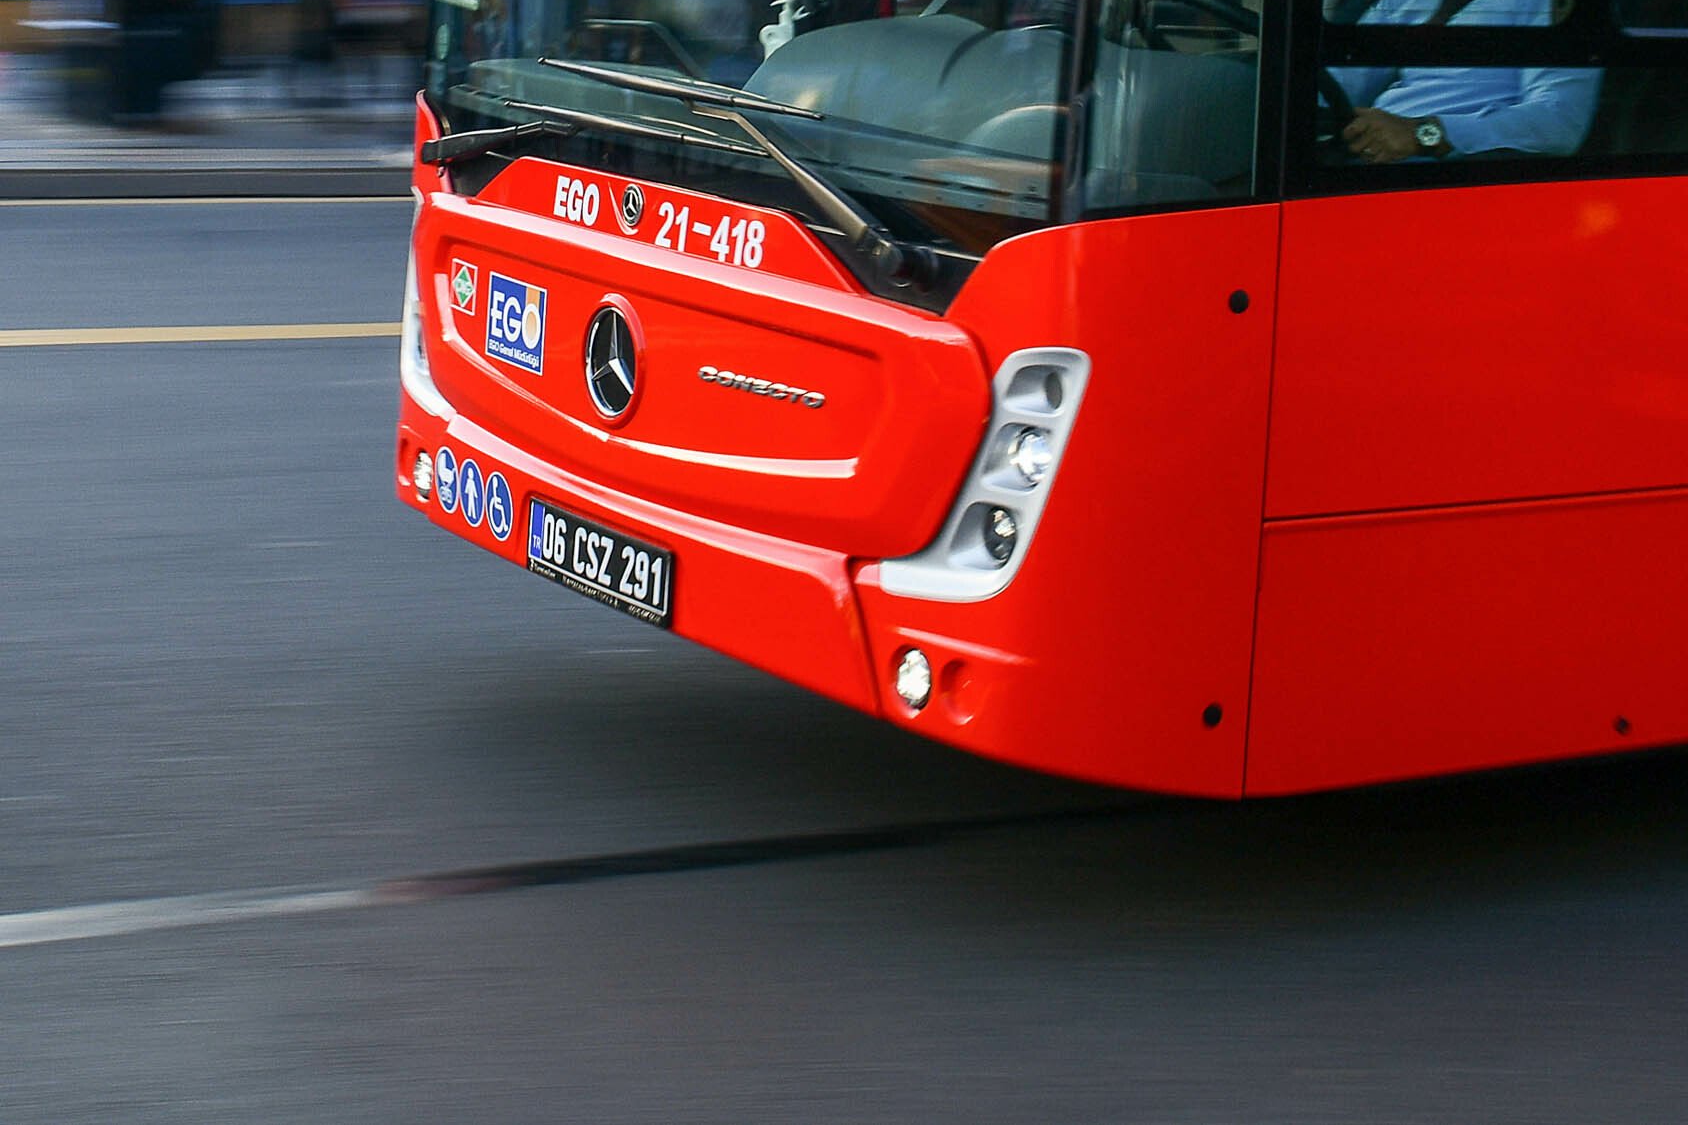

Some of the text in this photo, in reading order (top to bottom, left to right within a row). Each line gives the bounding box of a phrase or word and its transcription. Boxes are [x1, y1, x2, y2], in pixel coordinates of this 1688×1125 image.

[553, 175, 600, 226] EGO
[654, 201, 766, 269] 21-418
[491, 290, 541, 350] EGO
[698, 366, 826, 409] CONECTO
[533, 534, 542, 551] TR
[543, 513, 567, 565] 06
[573, 526, 614, 588] CSZ
[619, 545, 663, 606] 291
